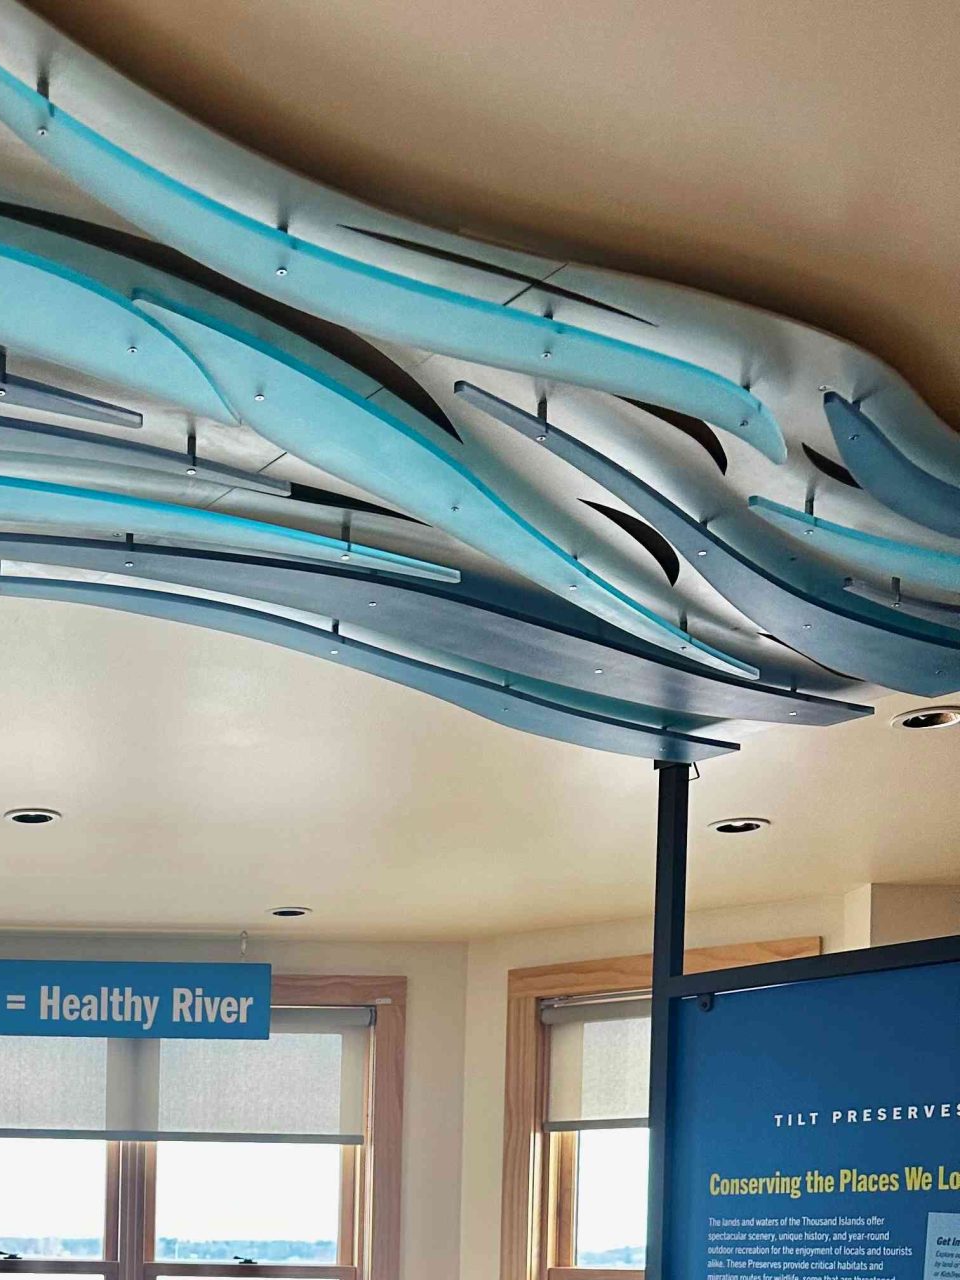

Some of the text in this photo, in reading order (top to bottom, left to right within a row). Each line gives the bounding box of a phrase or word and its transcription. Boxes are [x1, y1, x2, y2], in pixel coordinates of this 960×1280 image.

[7, 994, 26, 1010] =
[40, 986, 159, 1030] Healthy
[172, 987, 253, 1023] River
[775, 1112, 818, 1126] TILT
[710, 1172, 801, 1198] Conserving
[806, 1171, 834, 1192] the
[840, 1169, 899, 1192] Places
[905, 1167, 932, 1190] We
[709, 1216, 885, 1226] The lands and waters of the Thousand Islands offer
[708, 1231, 889, 1242] spectacular scenery, unique history, and year-round
[937, 1237, 951, 1246] Get
[708, 1245, 912, 1257] outdoor recreation for the enjoyment of locals and tourists
[727, 1259, 746, 1268] These
[748, 1260, 781, 1268] Preserves
[783, 1261, 809, 1270] provide
[811, 1261, 836, 1270] critical
[837, 1261, 867, 1270] habitats
[869, 1261, 883, 1270] and
